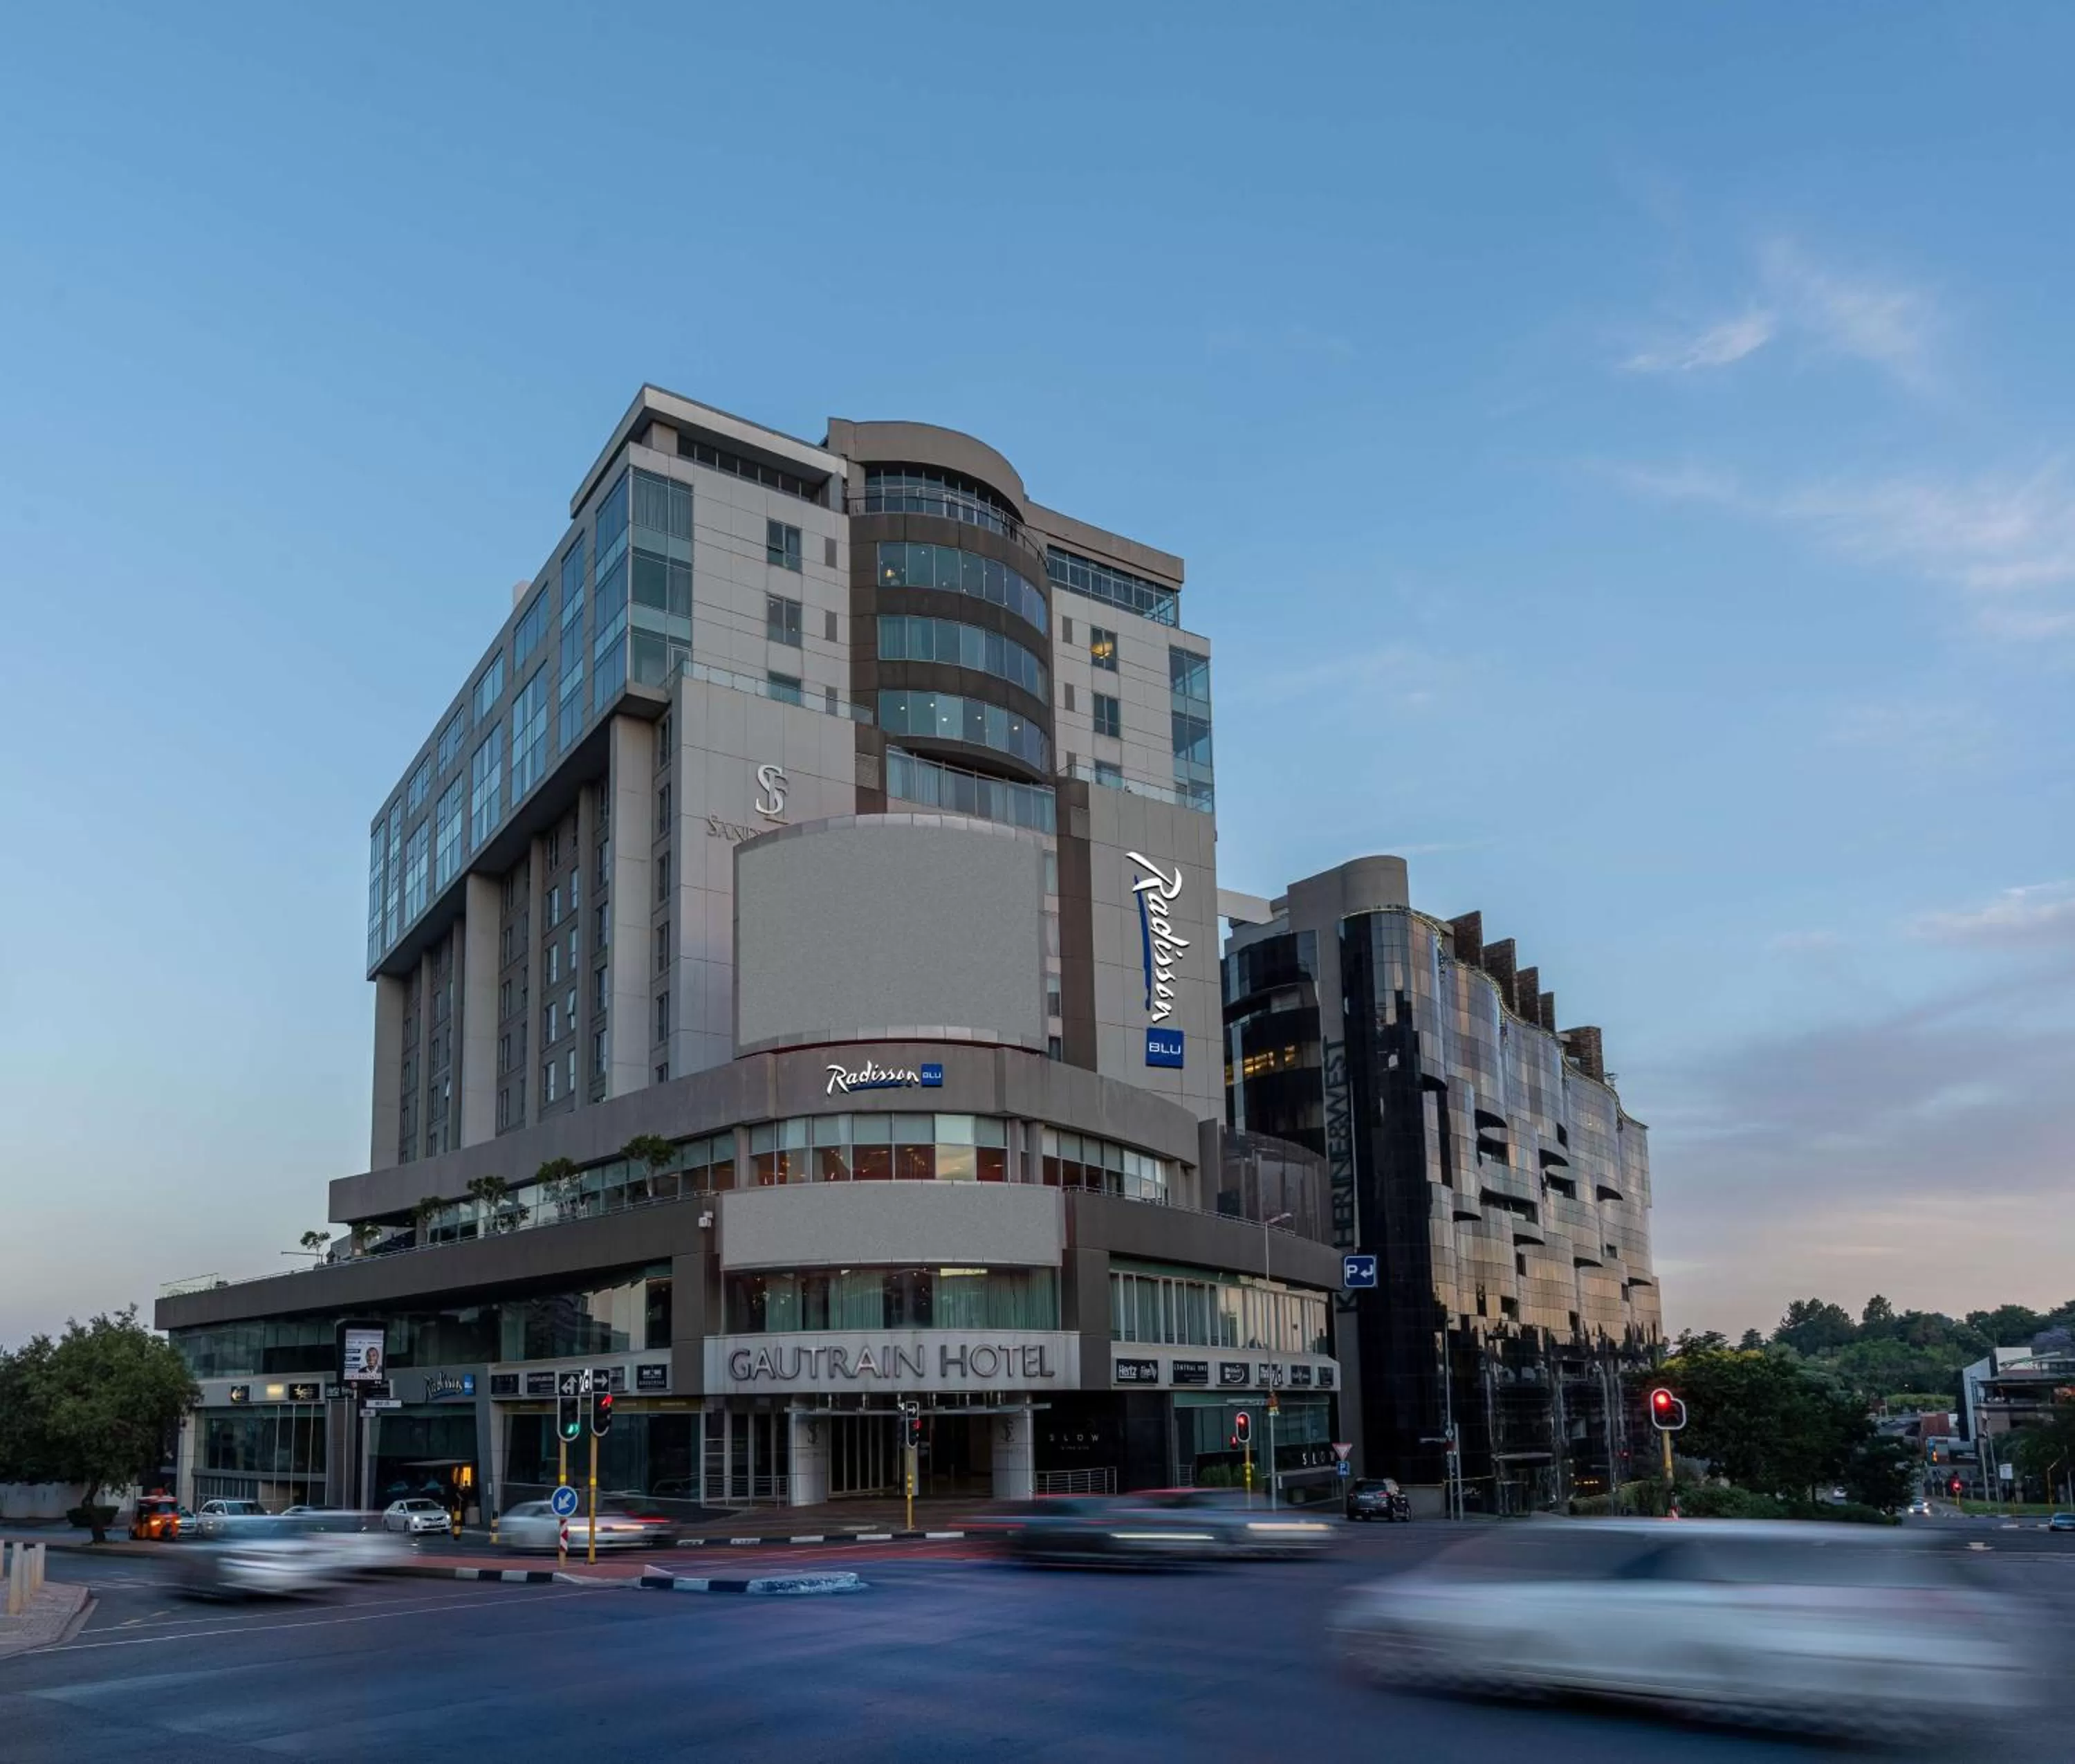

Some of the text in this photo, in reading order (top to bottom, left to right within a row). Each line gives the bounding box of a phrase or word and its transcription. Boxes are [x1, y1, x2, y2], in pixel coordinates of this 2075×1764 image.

[1125, 851, 1190, 1024] Radisson
[1149, 1041, 1181, 1054] BLU
[825, 1060, 920, 1096] Radisson
[1346, 1265, 1358, 1280] P
[728, 1343, 1055, 1381] GAUTRAIN HOTEL
[1118, 1364, 1137, 1376] Hertz
[1048, 1433, 1100, 1443] SLOW
